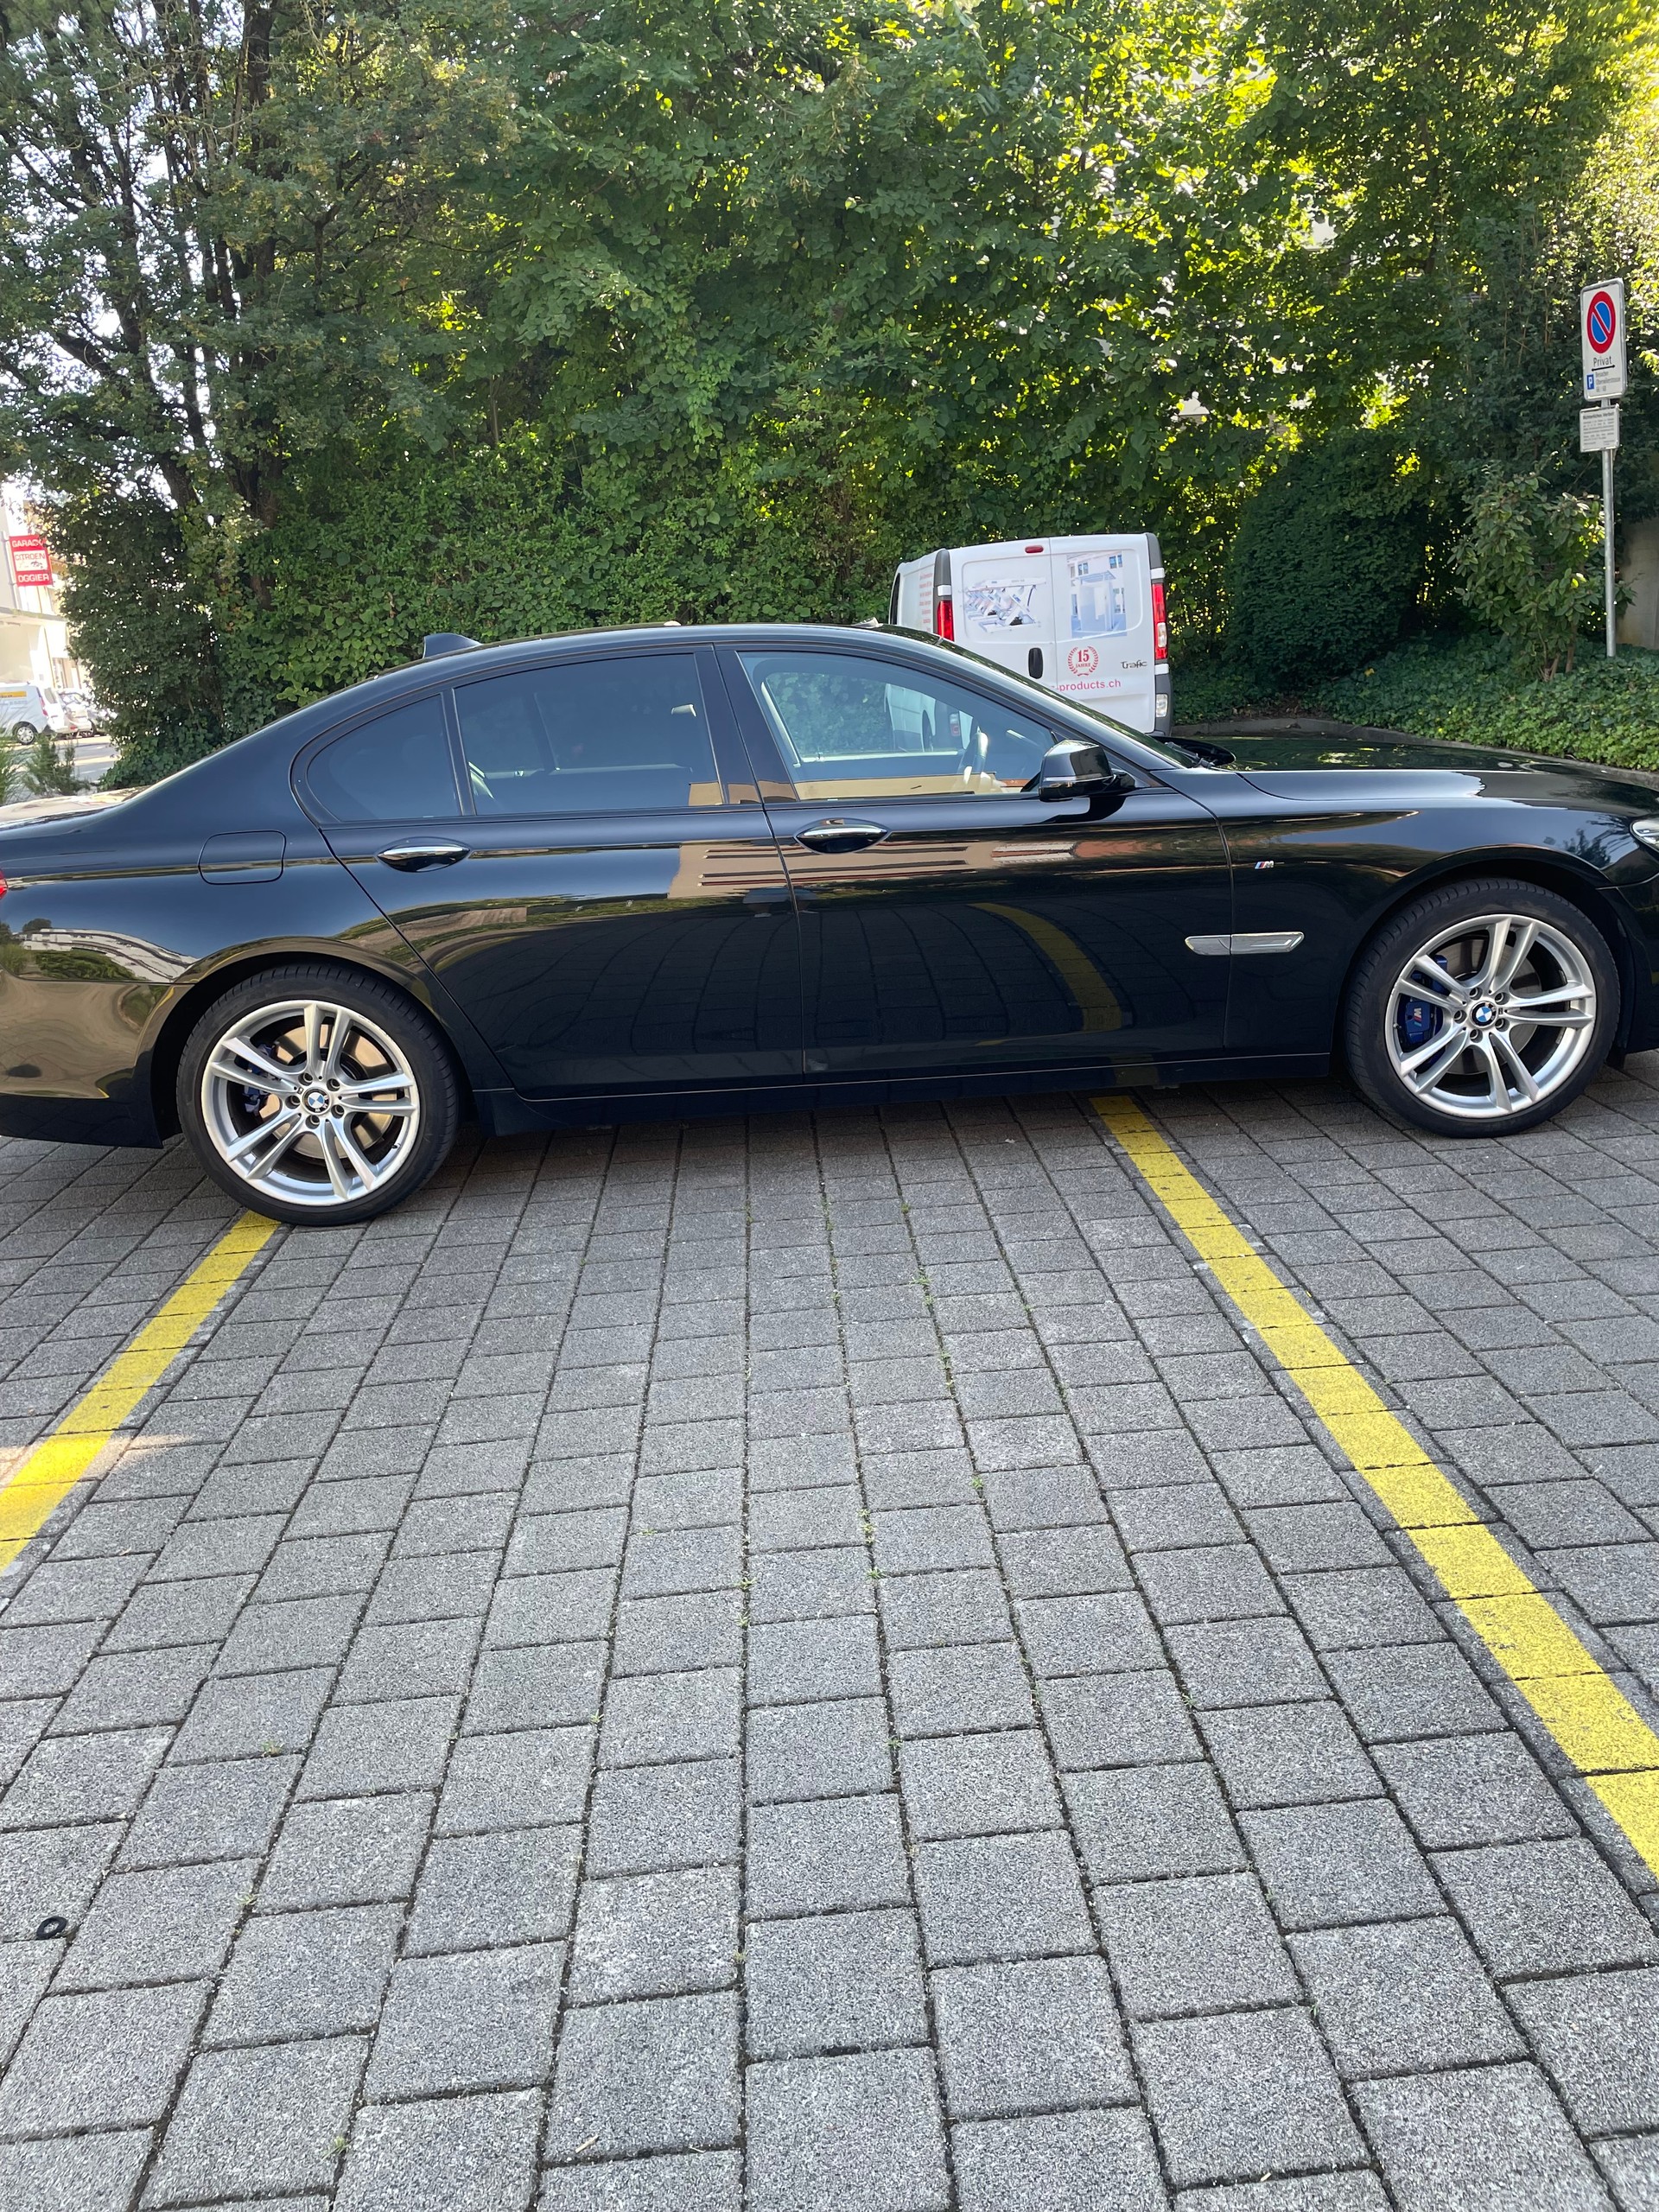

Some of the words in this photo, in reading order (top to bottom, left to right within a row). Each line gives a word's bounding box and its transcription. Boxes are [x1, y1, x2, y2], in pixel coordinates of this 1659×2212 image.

[1593, 356, 1612, 367] Privat
[17, 573, 50, 583] OGGIER
[1077, 649, 1090, 663] 15
[1121, 659, 1147, 670] Trafic
